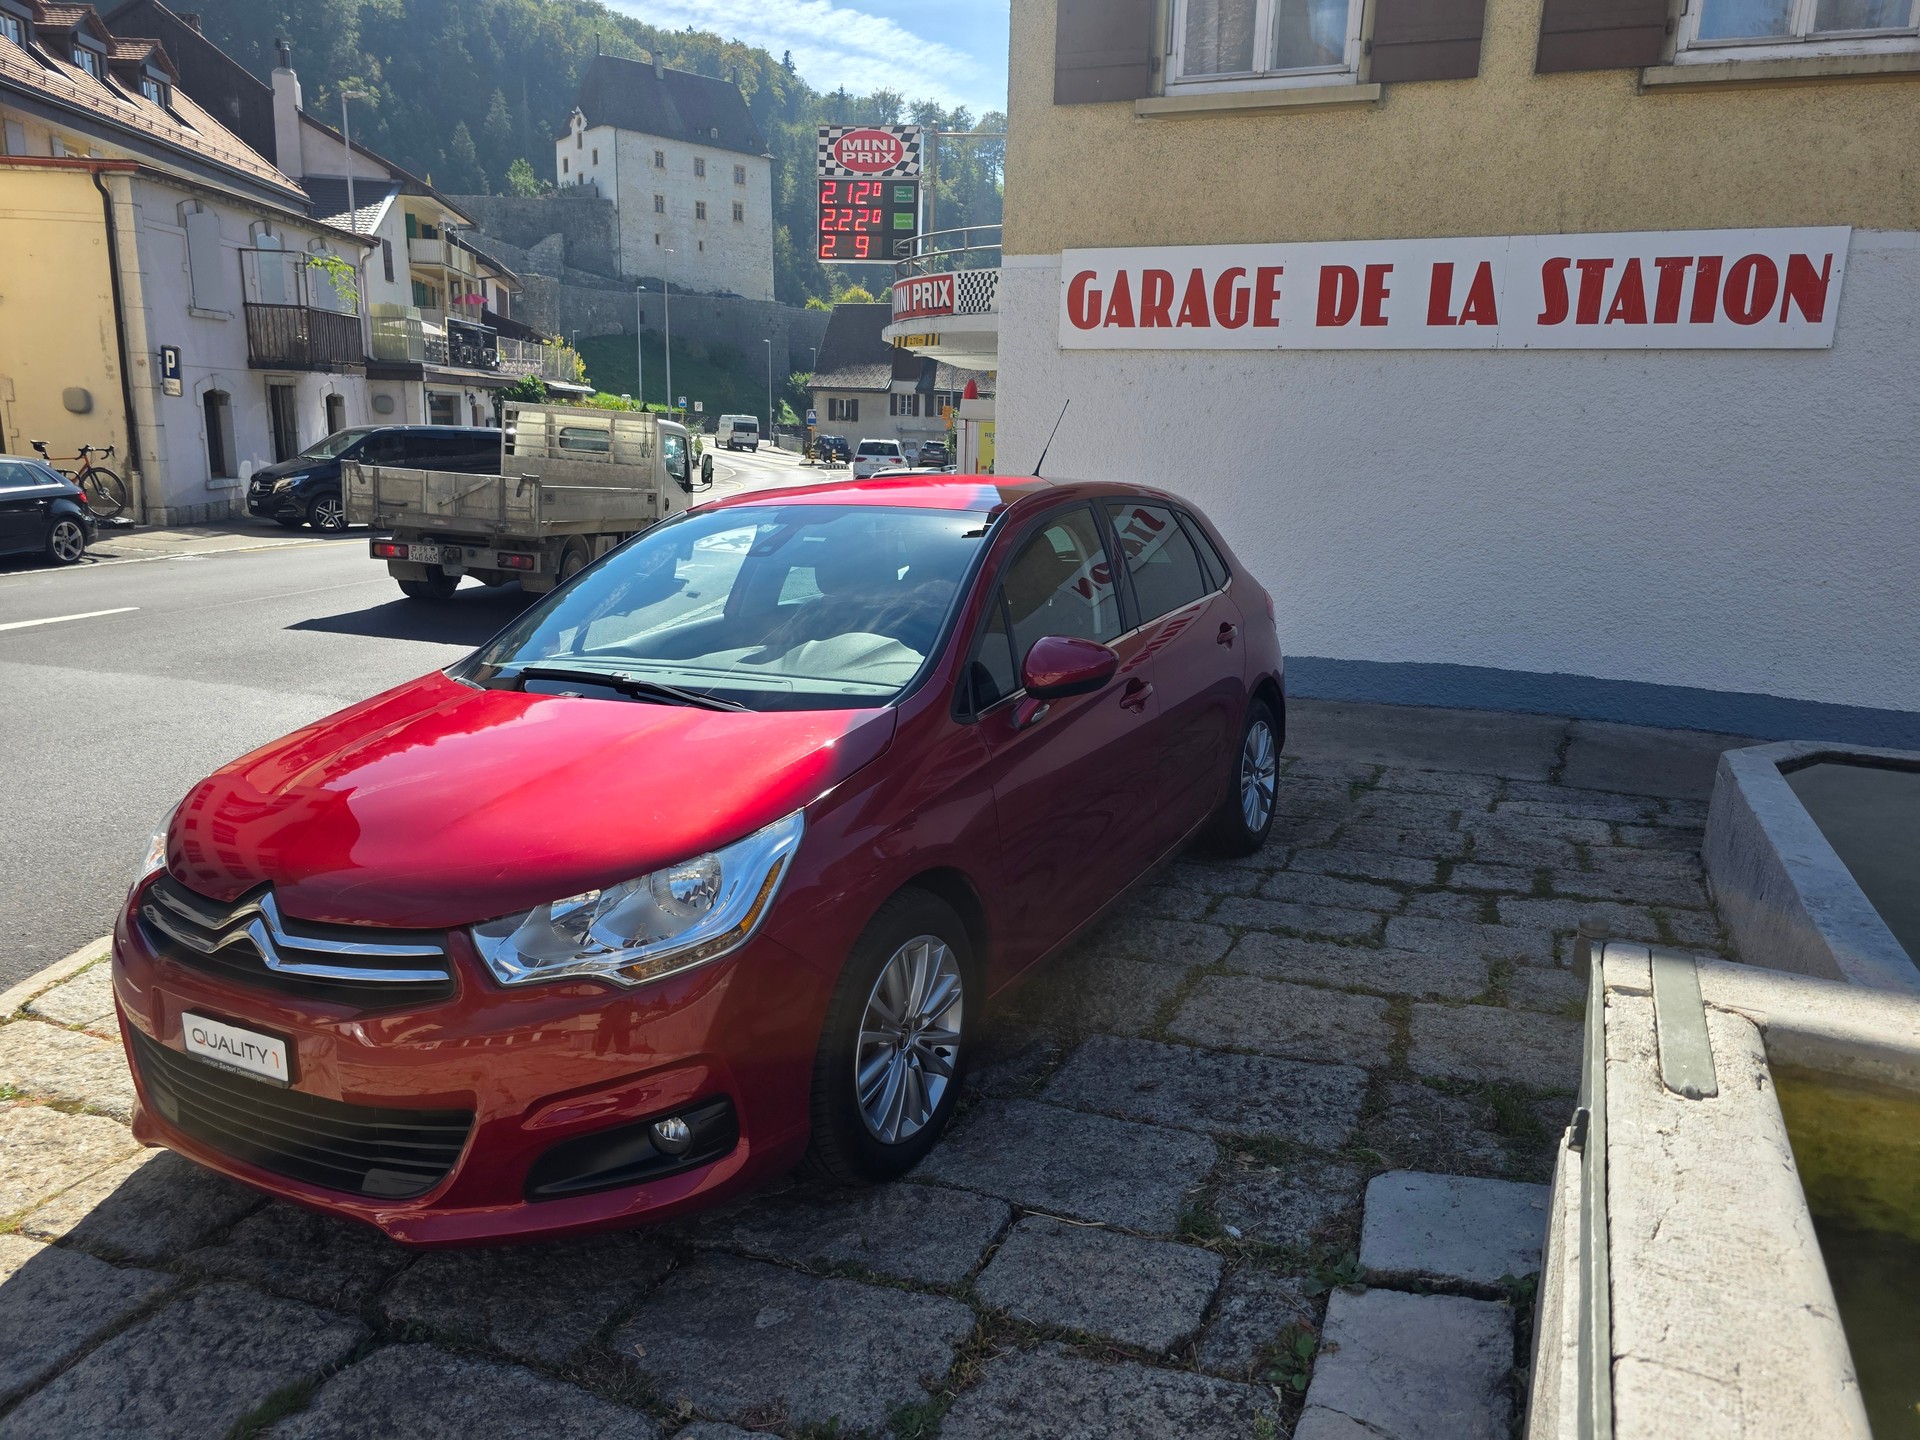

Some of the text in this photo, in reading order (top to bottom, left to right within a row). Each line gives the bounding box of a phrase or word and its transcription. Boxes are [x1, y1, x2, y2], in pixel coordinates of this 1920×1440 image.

[842, 139, 896, 151] MINI
[842, 152, 896, 164] PRIX
[912, 280, 951, 310] PRIX
[1067, 253, 1833, 330] GARAGE DE LA STATION
[166, 350, 176, 377] P
[192, 1027, 279, 1069] QUALITY 1
